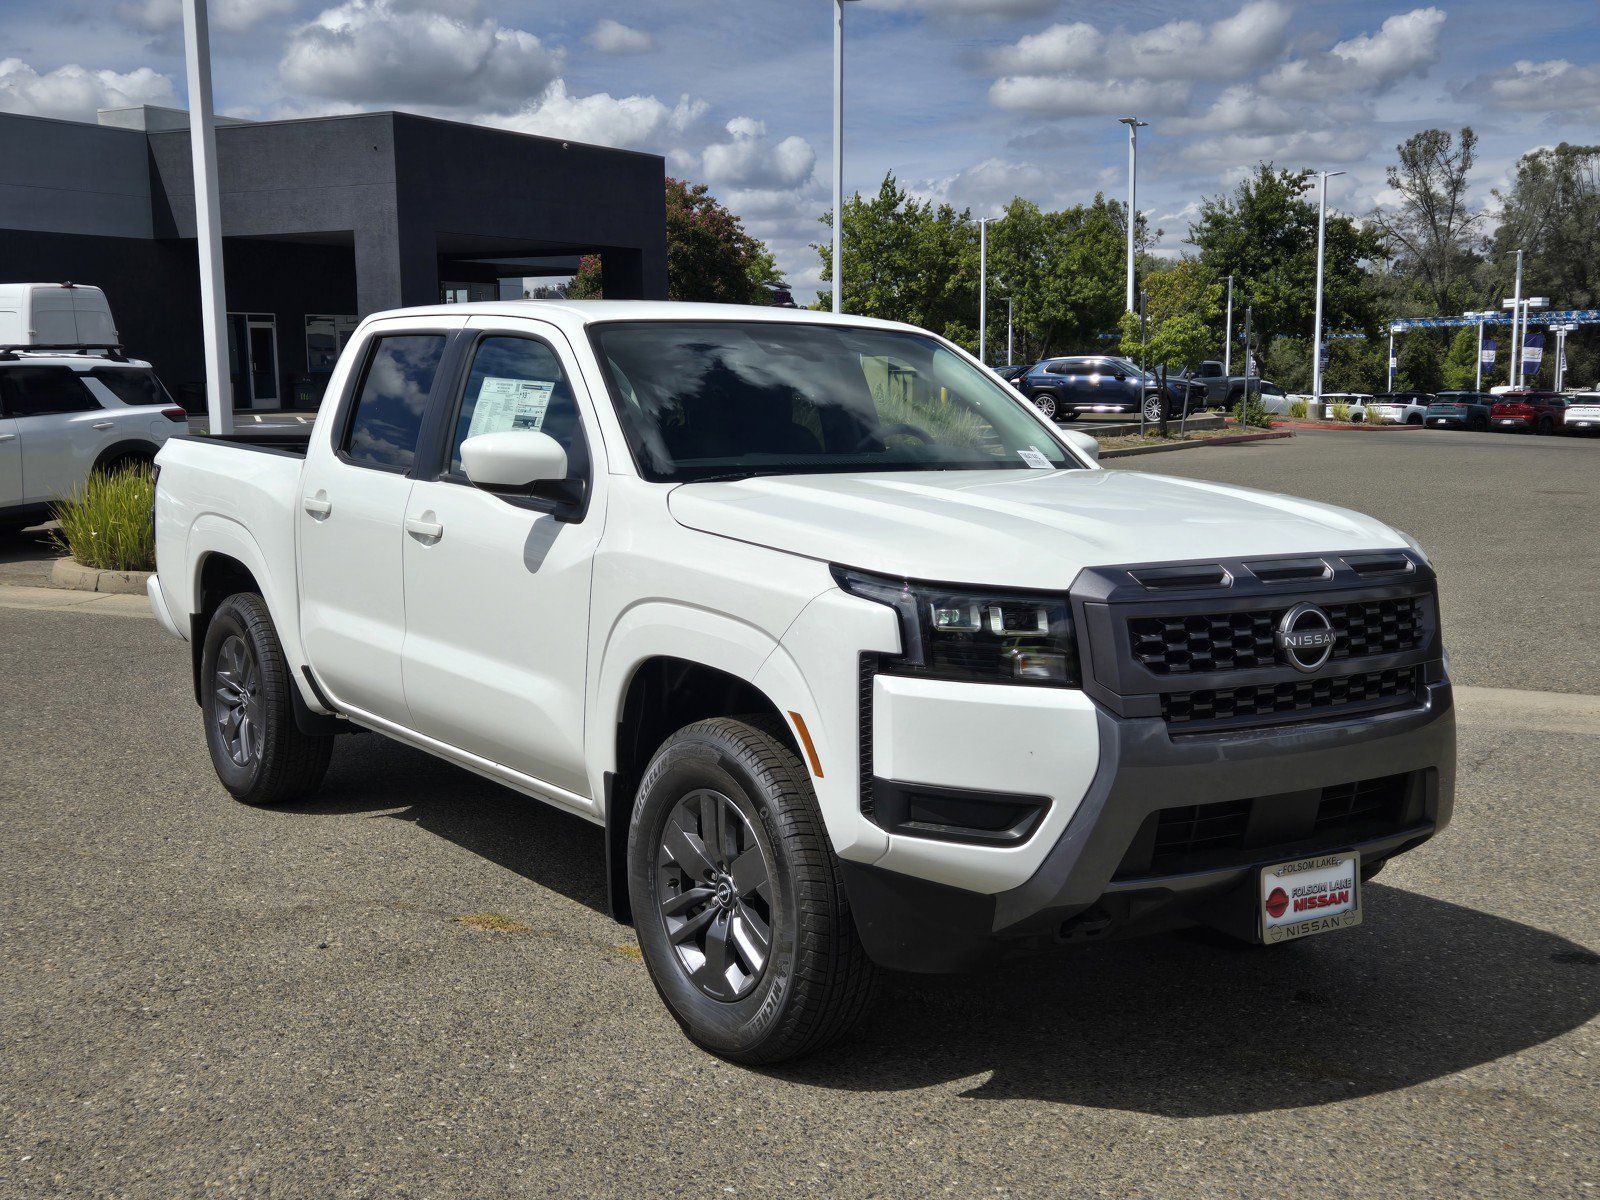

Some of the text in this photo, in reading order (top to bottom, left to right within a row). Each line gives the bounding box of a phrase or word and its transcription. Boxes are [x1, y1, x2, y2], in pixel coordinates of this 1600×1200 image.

[1284, 633, 1337, 646] NISSAN
[1283, 857, 1337, 873] FOLSOM LAKE
[1292, 878, 1352, 899] FOLSOM LAKE
[1293, 890, 1349, 912] NISSAN
[1286, 917, 1340, 937] NISSAN
[744, 980, 782, 1034] MICHE
